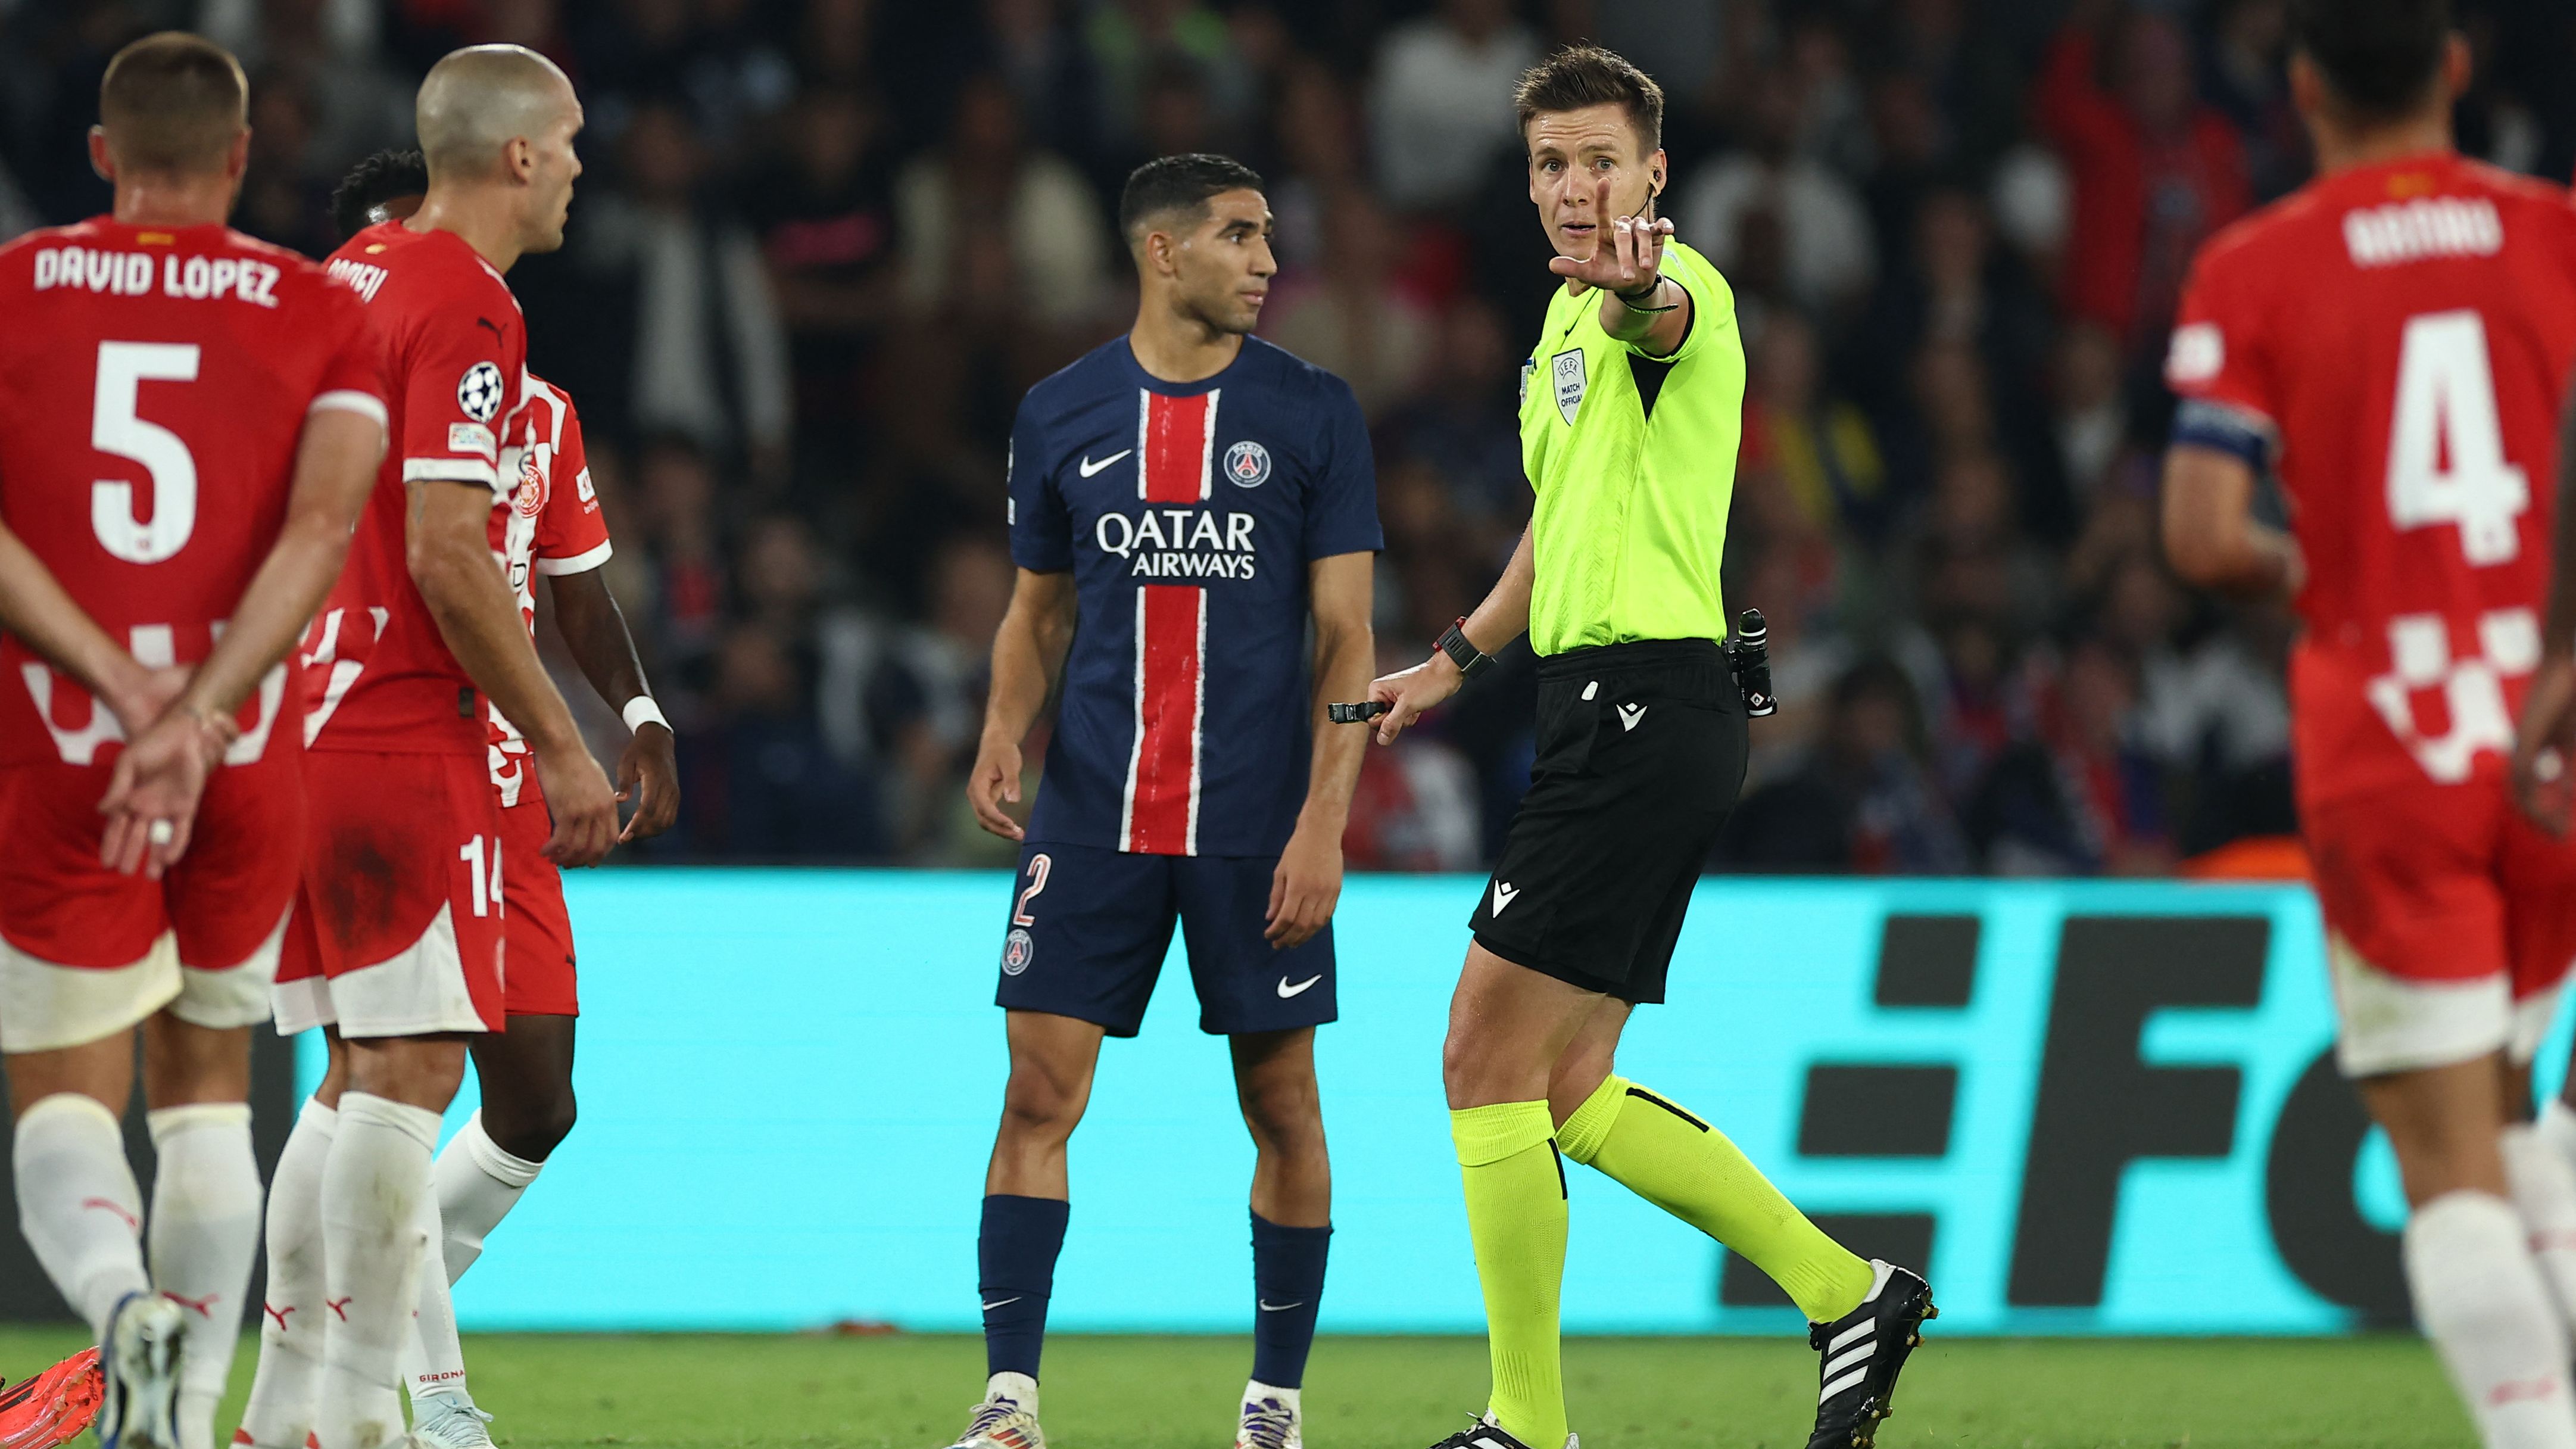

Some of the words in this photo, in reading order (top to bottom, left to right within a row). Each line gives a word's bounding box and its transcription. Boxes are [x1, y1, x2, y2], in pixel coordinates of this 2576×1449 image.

[34, 245, 154, 297] DAVID
[1558, 361, 1577, 376] UEFA
[1561, 382, 1580, 395] MATCH
[91, 340, 201, 565] 5
[2385, 308, 2533, 570] 4
[1096, 510, 1255, 559] QATAR
[1131, 553, 1255, 579] AIRWAYS
[1013, 853, 1052, 927] 2
[419, 1369, 465, 1382] GIRONA
